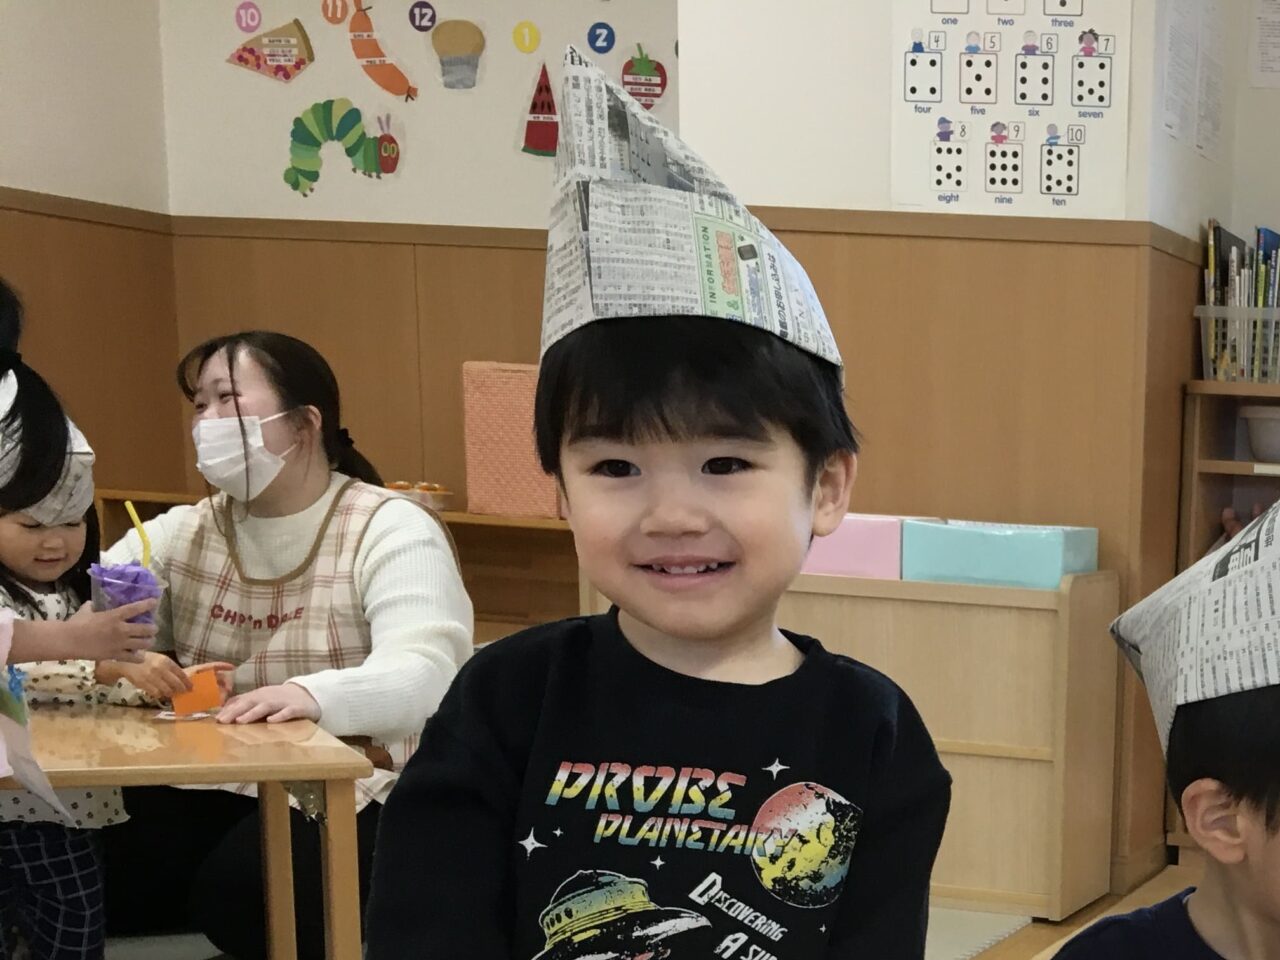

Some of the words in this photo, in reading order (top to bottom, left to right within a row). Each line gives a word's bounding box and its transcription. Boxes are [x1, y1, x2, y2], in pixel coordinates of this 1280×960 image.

[238, 8, 259, 28] 10
[412, 7, 433, 27] 12
[941, 16, 959, 25] one
[997, 17, 1015, 26] two
[1051, 18, 1075, 28] three
[594, 28, 608, 47] 2
[933, 34, 940, 49] 4
[988, 35, 996, 50] 5
[1045, 37, 1053, 51] 6
[1103, 38, 1111, 52] 7
[914, 104, 932, 114] four
[970, 105, 986, 115] five
[1028, 108, 1040, 117] six
[1077, 110, 1104, 119] seven
[959, 124, 967, 138] 8
[1013, 125, 1021, 139] 9
[1069, 127, 1084, 142] 10
[937, 193, 960, 204] eight
[994, 195, 1013, 205] nine
[1052, 197, 1067, 207] ten
[545, 761, 748, 820] PROBE
[593, 813, 801, 858] PLANETARY
[688, 871, 789, 942] DISCOVERING
[713, 932, 749, 960] A
